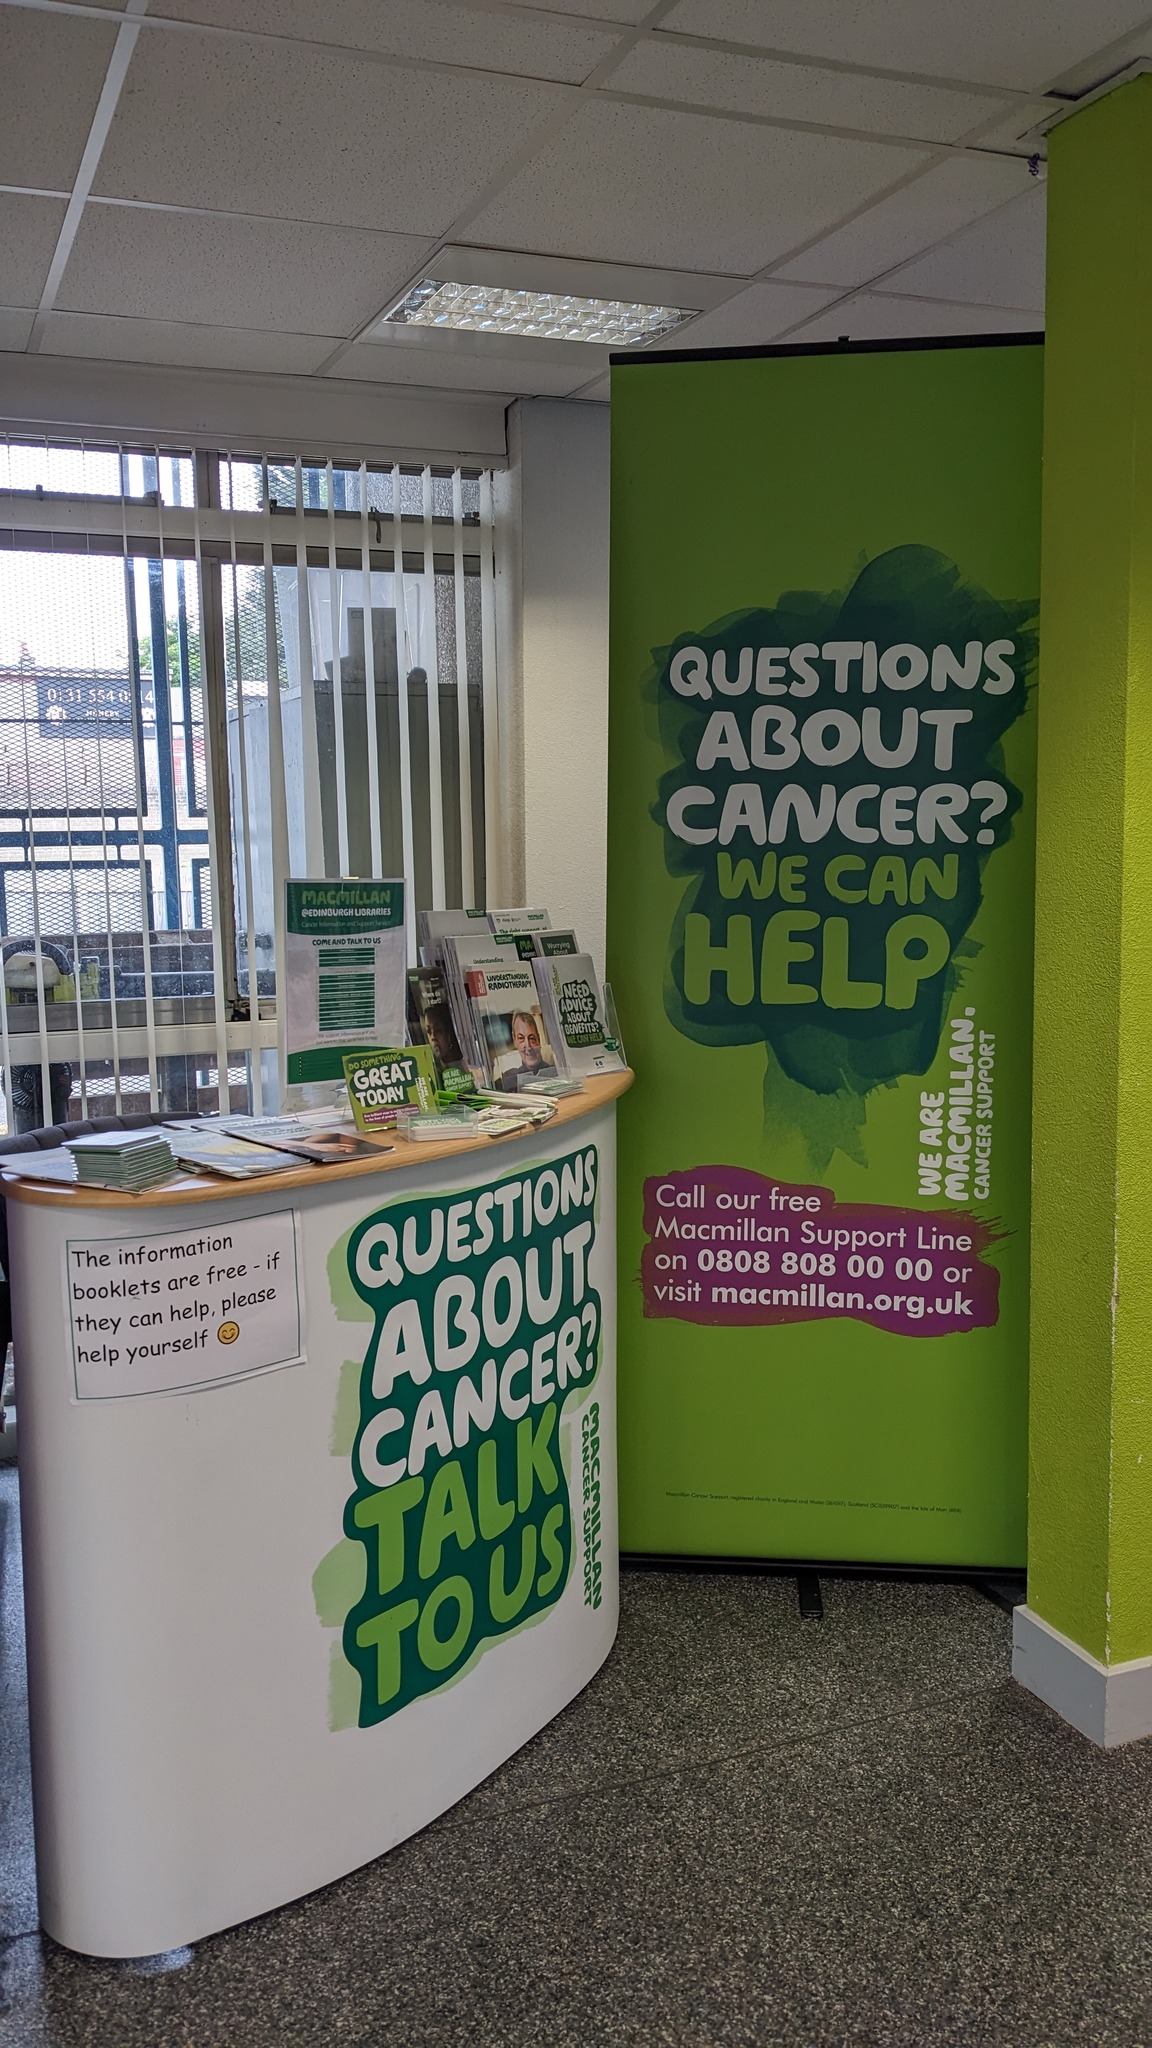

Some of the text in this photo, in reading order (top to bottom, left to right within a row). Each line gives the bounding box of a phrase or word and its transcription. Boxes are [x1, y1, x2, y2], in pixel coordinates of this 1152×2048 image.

[669, 639, 1015, 700] QUESTIONS
[696, 705, 973, 771] ABOUT
[666, 781, 1007, 845] CANCER?
[301, 890, 391, 905] MACMILLAN
[716, 852, 958, 905] WE CAN
[301, 907, 392, 918] @EDINBURGH LIBRARIES
[312, 938, 331, 946] COME
[547, 942, 570, 950] Worrying
[683, 910, 950, 1009] HELP
[486, 973, 529, 982] UNDERSTANDING
[488, 980, 532, 990] RADIOTHERAPY
[563, 983, 590, 999] NEED
[560, 998, 594, 1013] ADVICE
[566, 1012, 591, 1023] ABOUT
[564, 1022, 599, 1035] BENEFITS?
[348, 1053, 401, 1070] DO SOMETHING
[354, 1061, 412, 1090] GREAT
[355, 1085, 404, 1108] TODAY
[944, 1007, 976, 1201] MACMILLAN.
[974, 1030, 995, 1200] CANCER SUPPORT
[918, 1091, 944, 1195] WE ARE
[656, 1185, 821, 1213] Call our free
[355, 1149, 595, 1289] QUESTIONS
[654, 1216, 972, 1252] Macmillan Support Line
[72, 1236, 233, 1268] The information
[655, 1249, 972, 1283] on 0808 808 00 00 or
[73, 1279, 161, 1300] booklets
[168, 1274, 201, 1291] are
[206, 1263, 248, 1285] free
[266, 1251, 280, 1270] if
[75, 1287, 277, 1335] they can help, please
[371, 1220, 592, 1400] ABOUT
[653, 1279, 973, 1318] visit macmillan.org.uk
[77, 1329, 209, 1367] help yourself
[359, 1302, 597, 1488] CANCER?
[354, 1401, 559, 1596] TALK
[581, 1414, 592, 1606] CANCER SUPPORT
[589, 1402, 602, 1610] MACMILLAN
[778, 1497, 797, 1505] England
[356, 1503, 564, 1706] TO US
